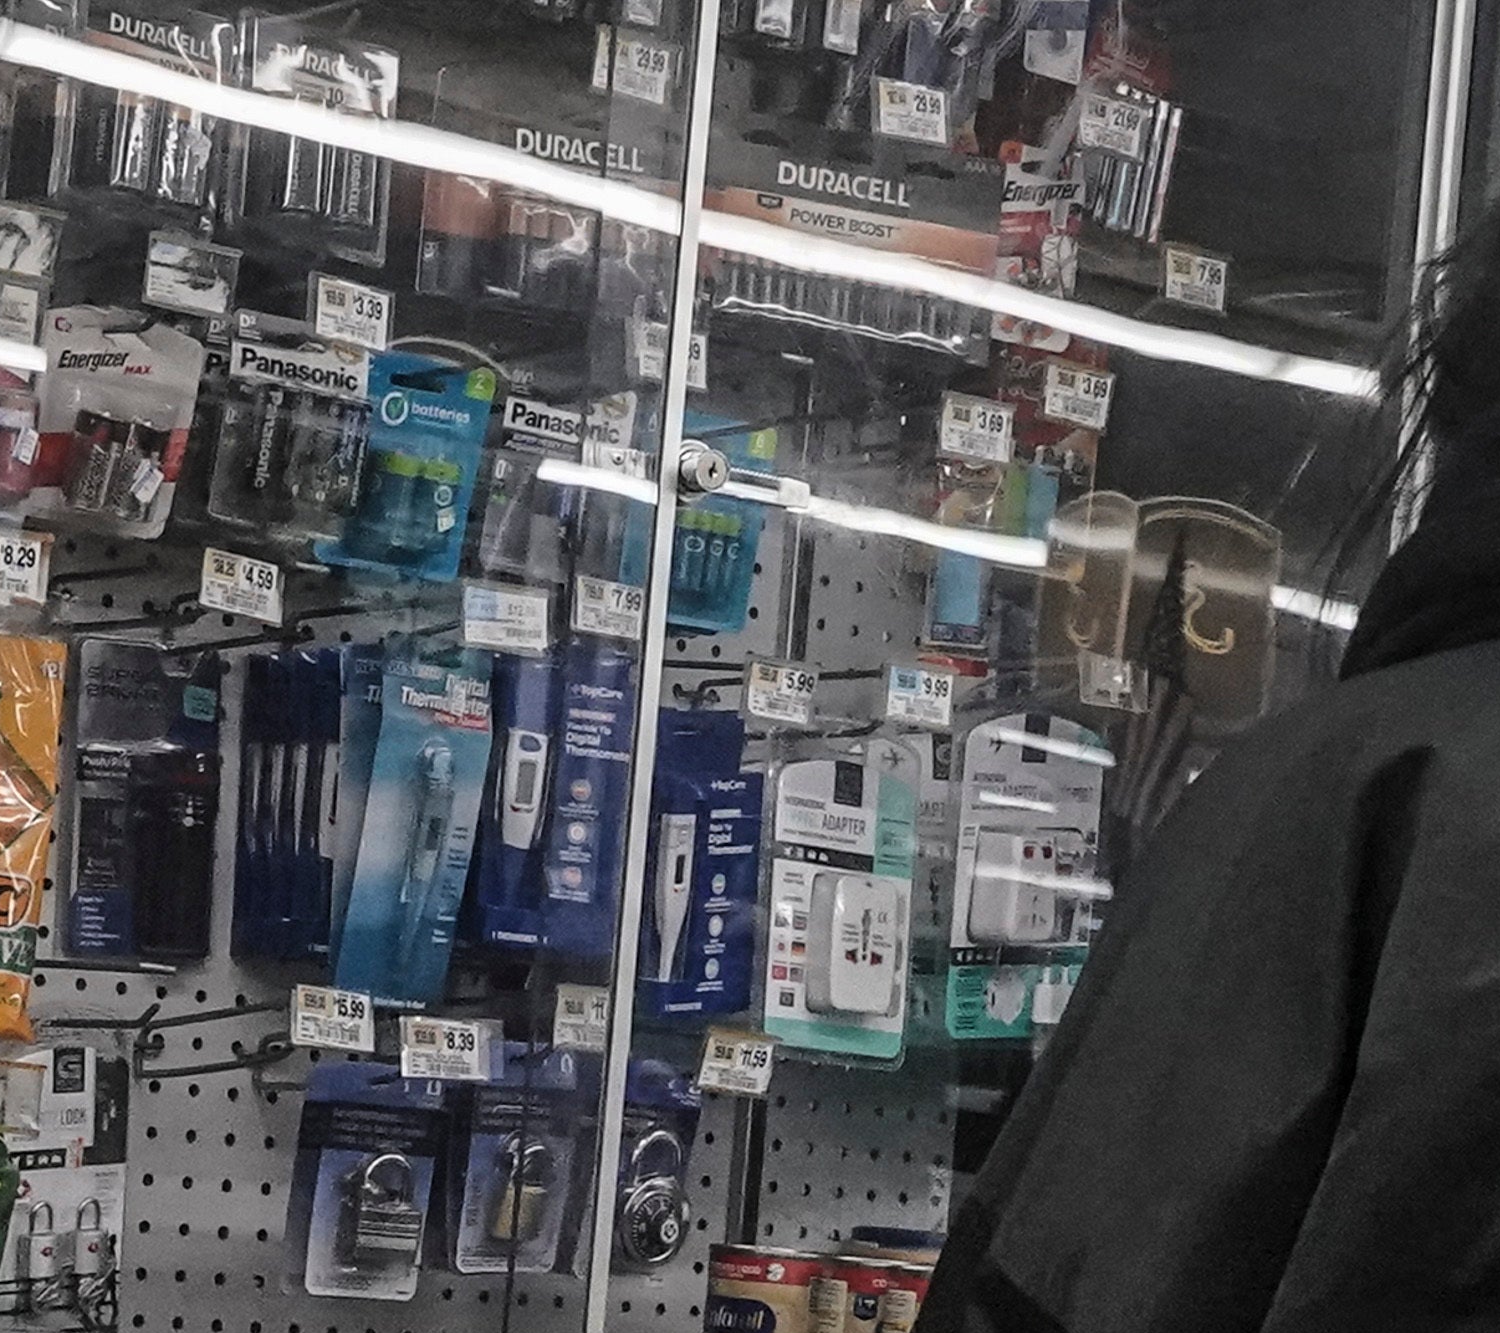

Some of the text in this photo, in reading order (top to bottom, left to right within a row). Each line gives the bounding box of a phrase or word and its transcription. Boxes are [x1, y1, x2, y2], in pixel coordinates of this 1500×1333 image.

[110, 12, 211, 61] DURACELL
[516, 128, 644, 173] DURACELL
[777, 161, 911, 208] DURACELL
[790, 208, 894, 239] POWER BOOST
[57, 349, 151, 376] Energizer MAX
[240, 347, 358, 392] Panasonic
[411, 401, 471, 427] batteries
[254, 388, 284, 489] Panasonic
[0, 543, 36, 569] $8.29
[243, 564, 274, 592] $4.59
[821, 811, 867, 837] ADAPTER
